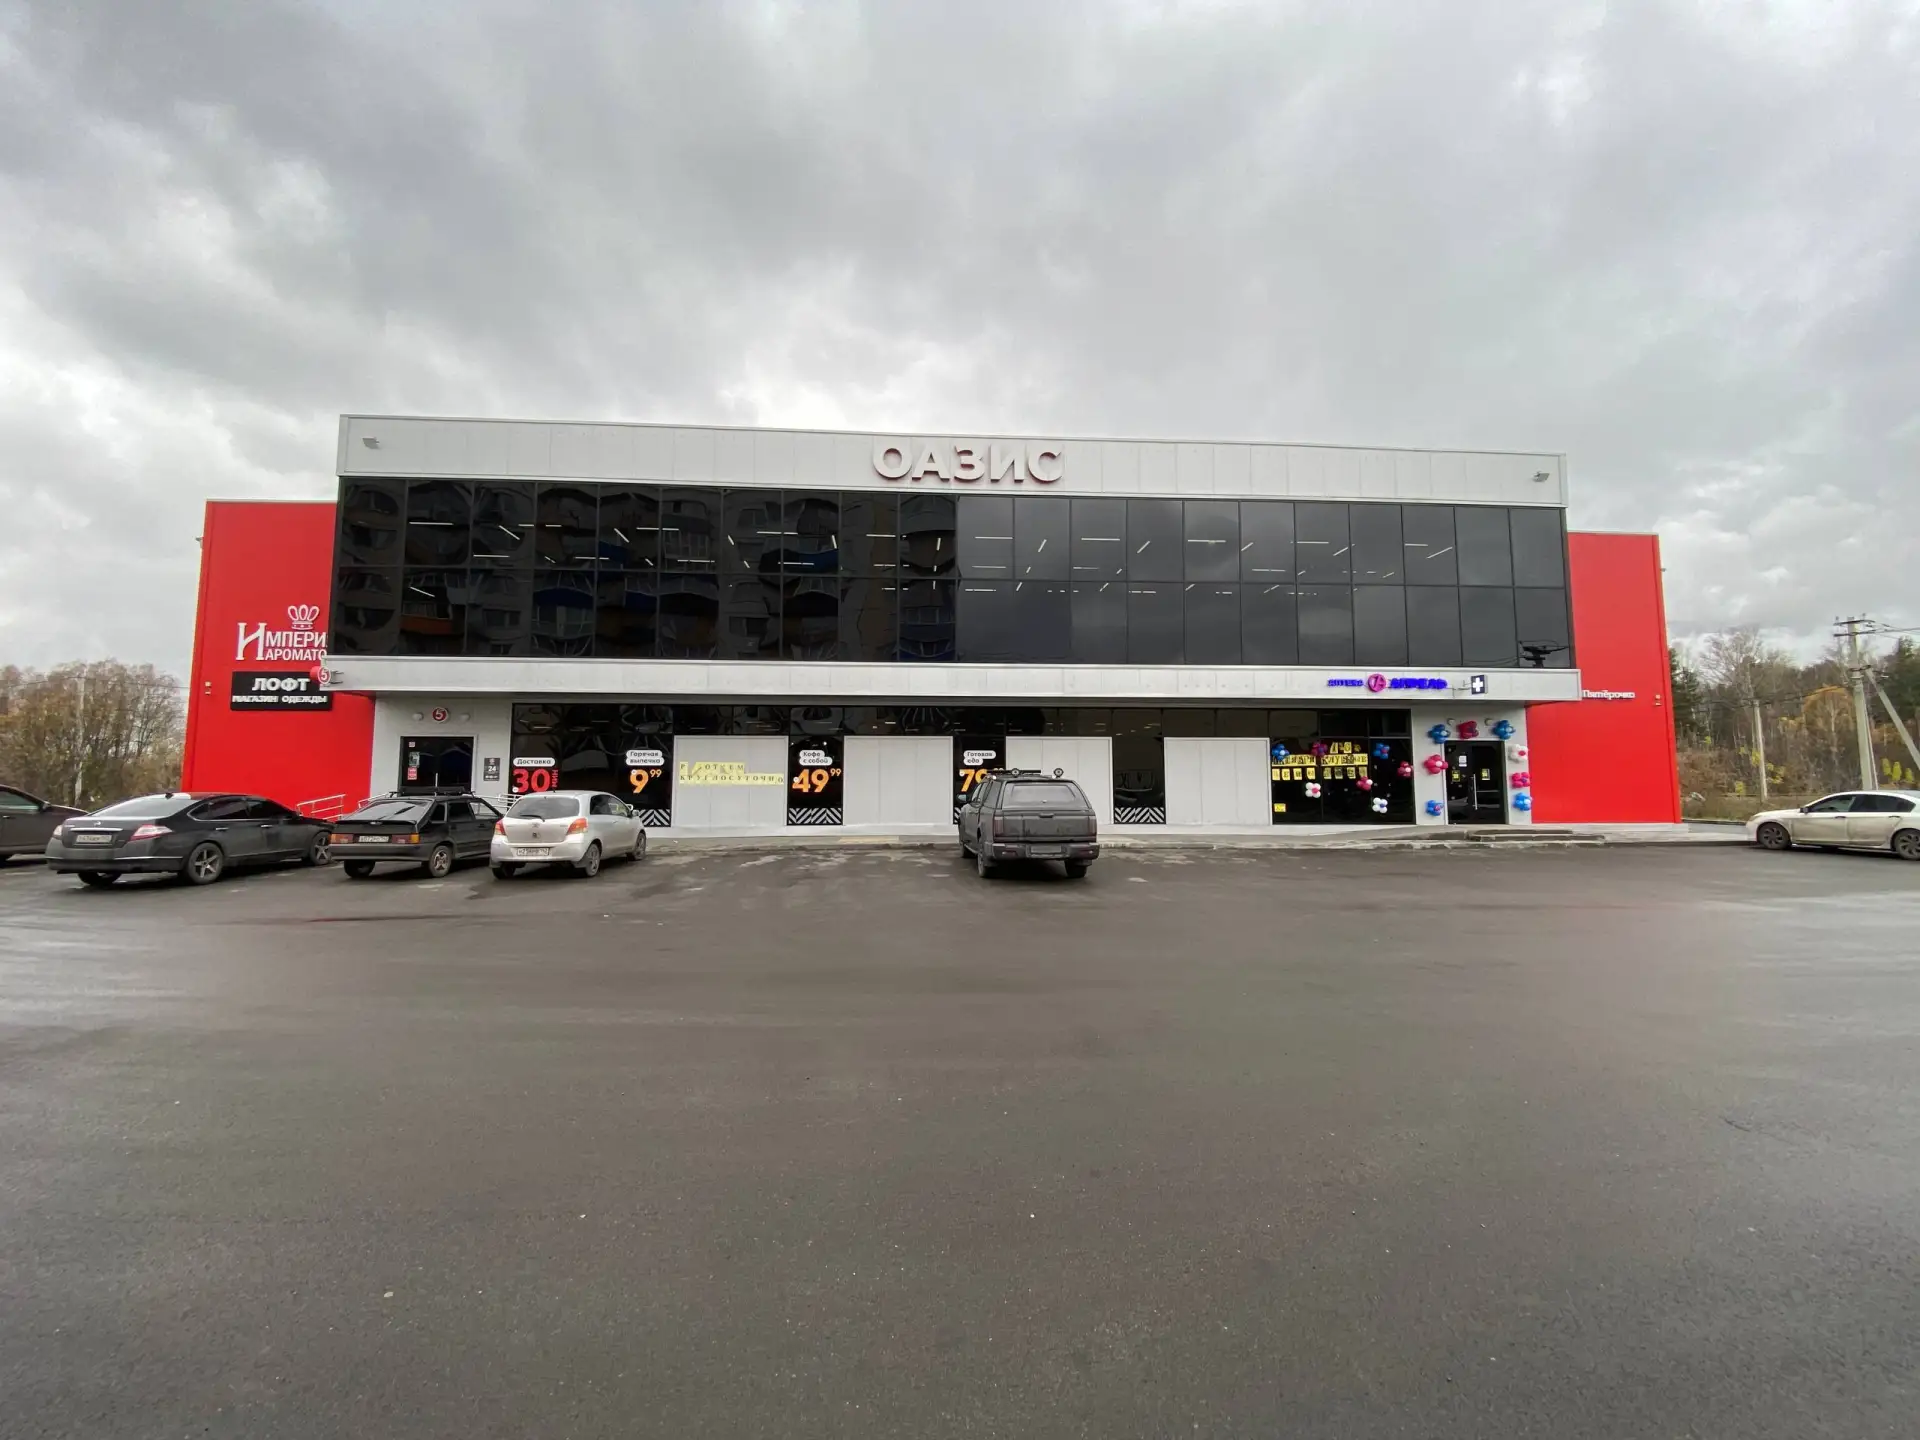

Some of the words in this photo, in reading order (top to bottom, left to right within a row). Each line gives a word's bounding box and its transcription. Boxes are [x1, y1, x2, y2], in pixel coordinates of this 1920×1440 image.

[872, 442, 1064, 482] ОАЗИС
[235, 622, 327, 661] ИМПЕРИ
[252, 678, 310, 691] ЛОФТ
[281, 696, 328, 704] ОДЕЖДЫ
[513, 768, 551, 792] 30
[680, 774, 784, 783] КРУГЛОСУТОЧНО
[792, 769, 829, 792] 49
[830, 768, 842, 776] 99
